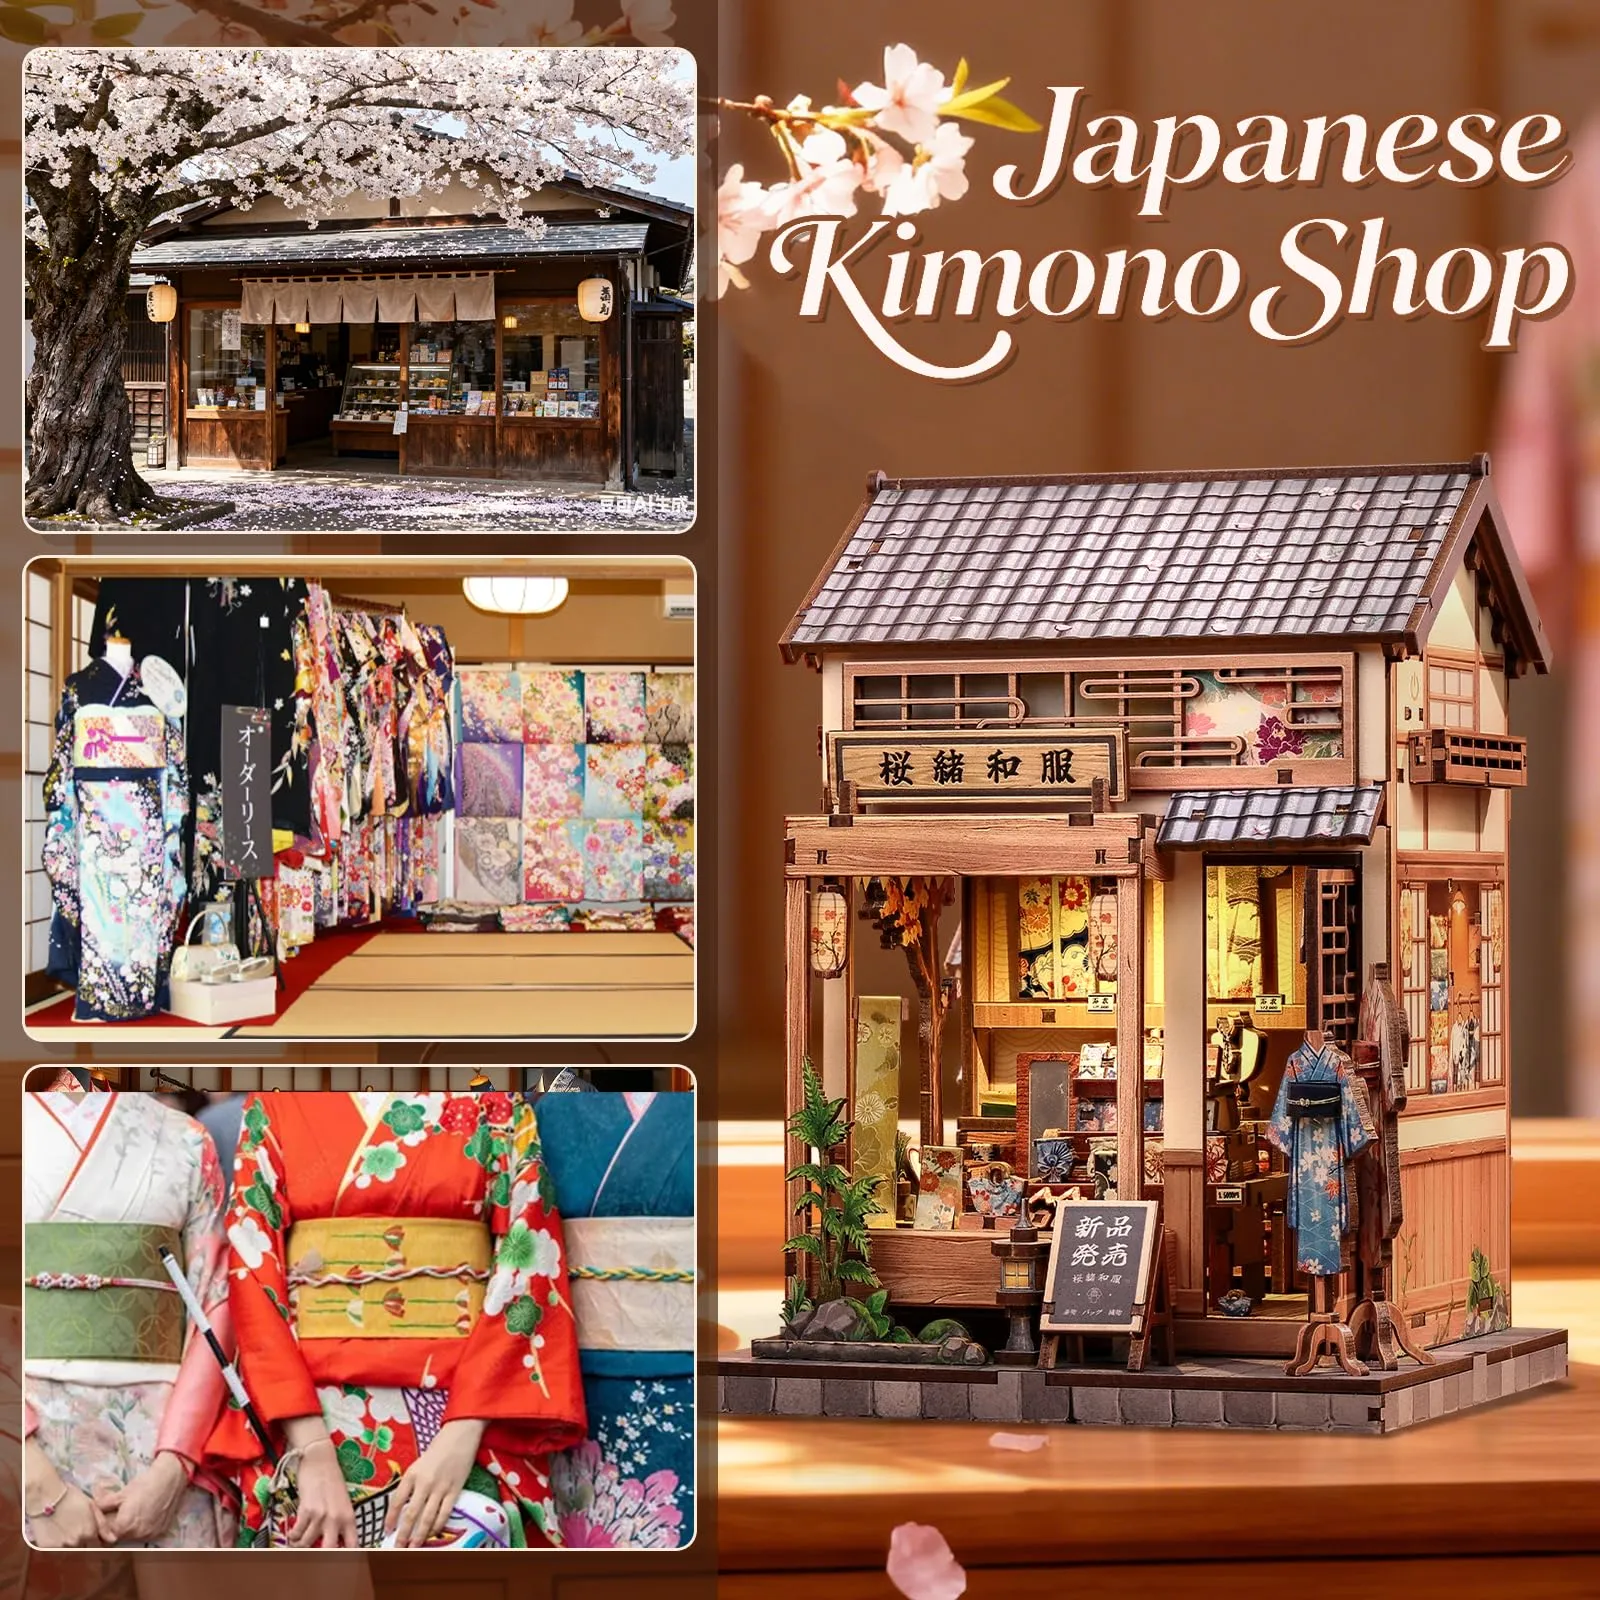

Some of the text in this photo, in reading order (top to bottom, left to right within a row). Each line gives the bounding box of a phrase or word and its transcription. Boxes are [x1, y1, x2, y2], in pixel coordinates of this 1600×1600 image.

[878, 748, 1077, 786] 桜緒和服
[238, 725, 258, 860] オーダーリース
[1074, 1215, 1133, 1239] 新品
[1070, 1242, 1129, 1267] 発売
